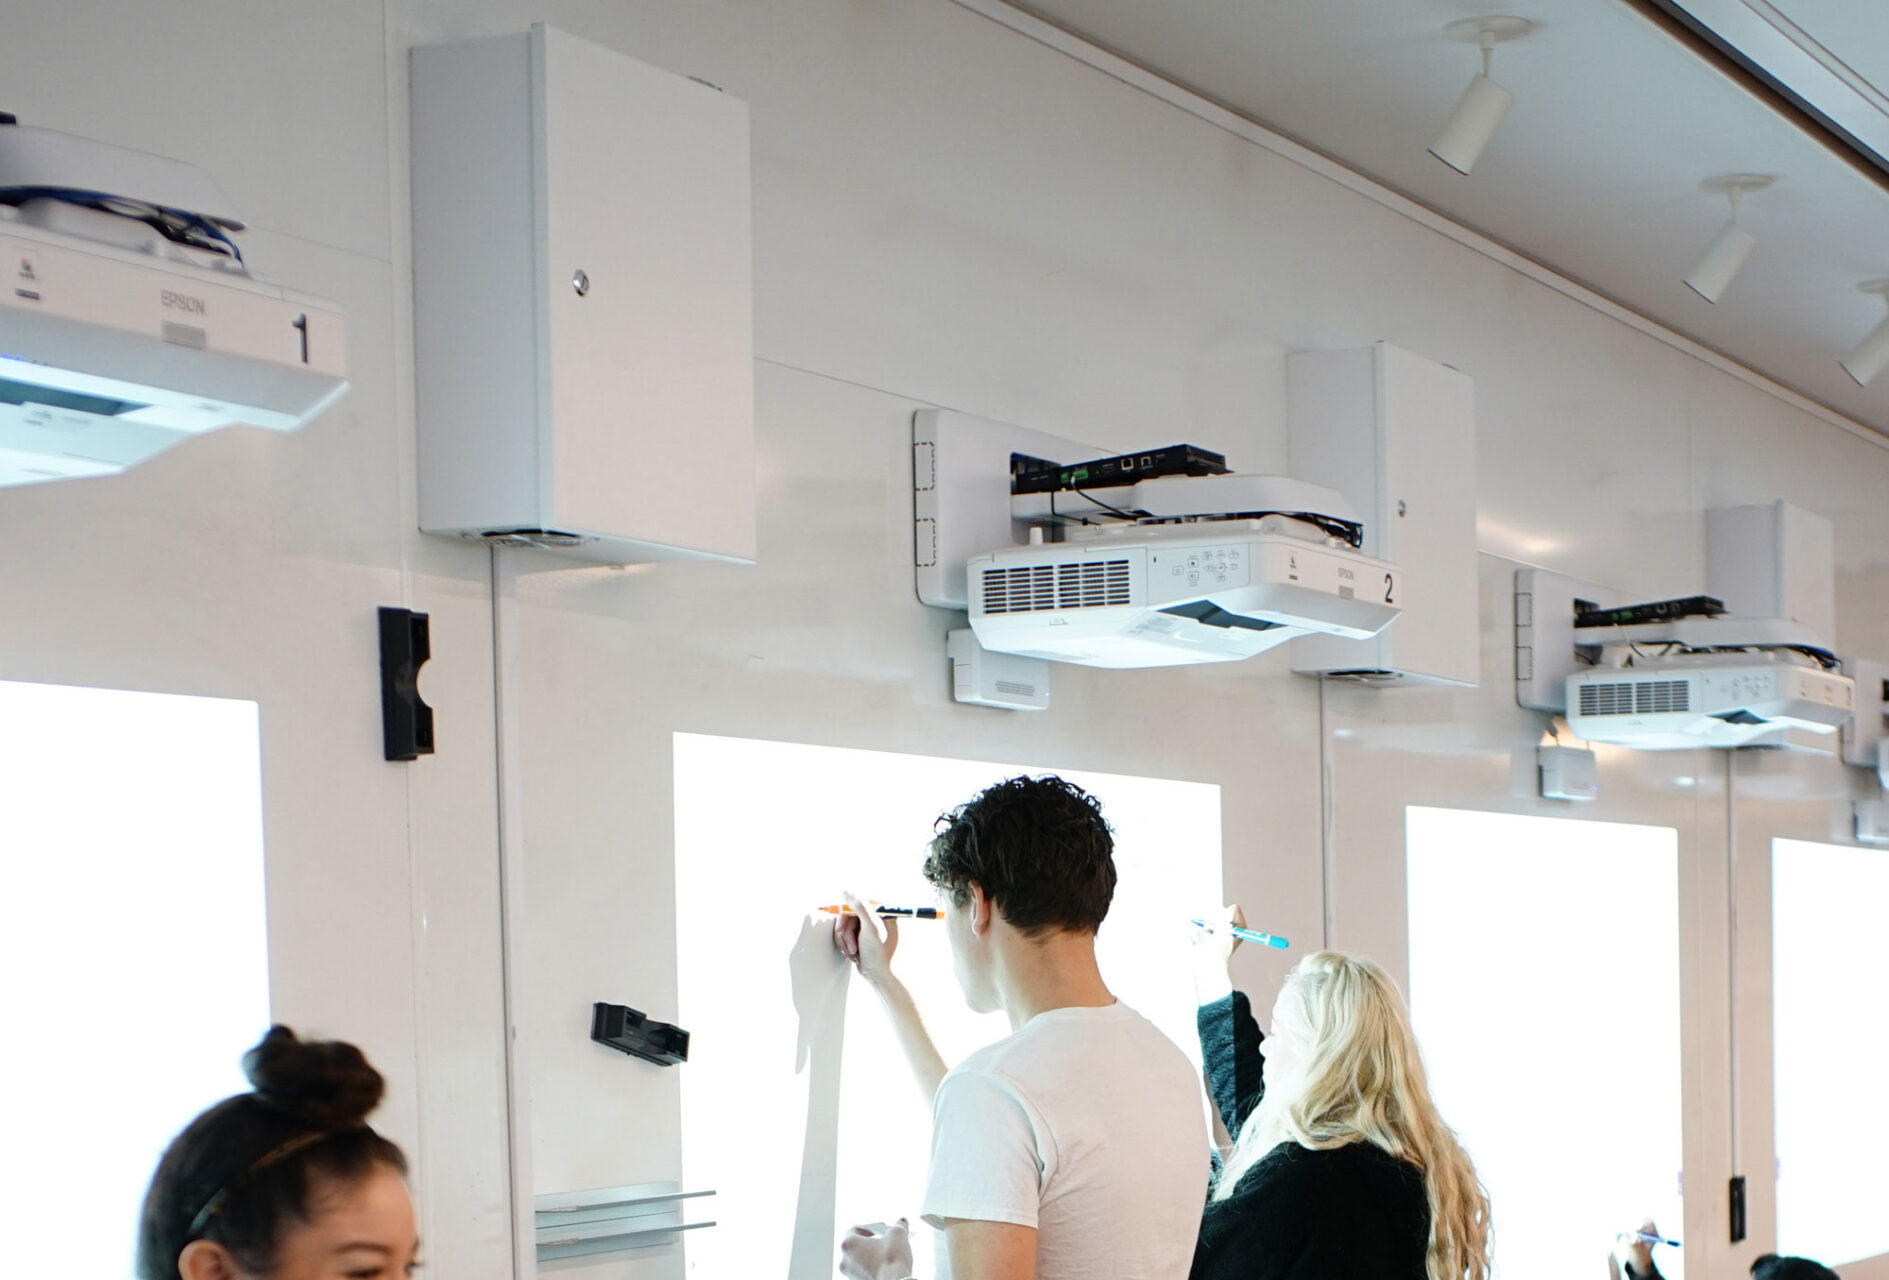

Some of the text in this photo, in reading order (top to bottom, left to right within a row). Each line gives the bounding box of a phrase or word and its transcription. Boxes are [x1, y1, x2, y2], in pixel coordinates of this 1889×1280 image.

[161, 289, 205, 315] EPSON
[292, 313, 308, 363] 1
[1384, 572, 1393, 604] 2
